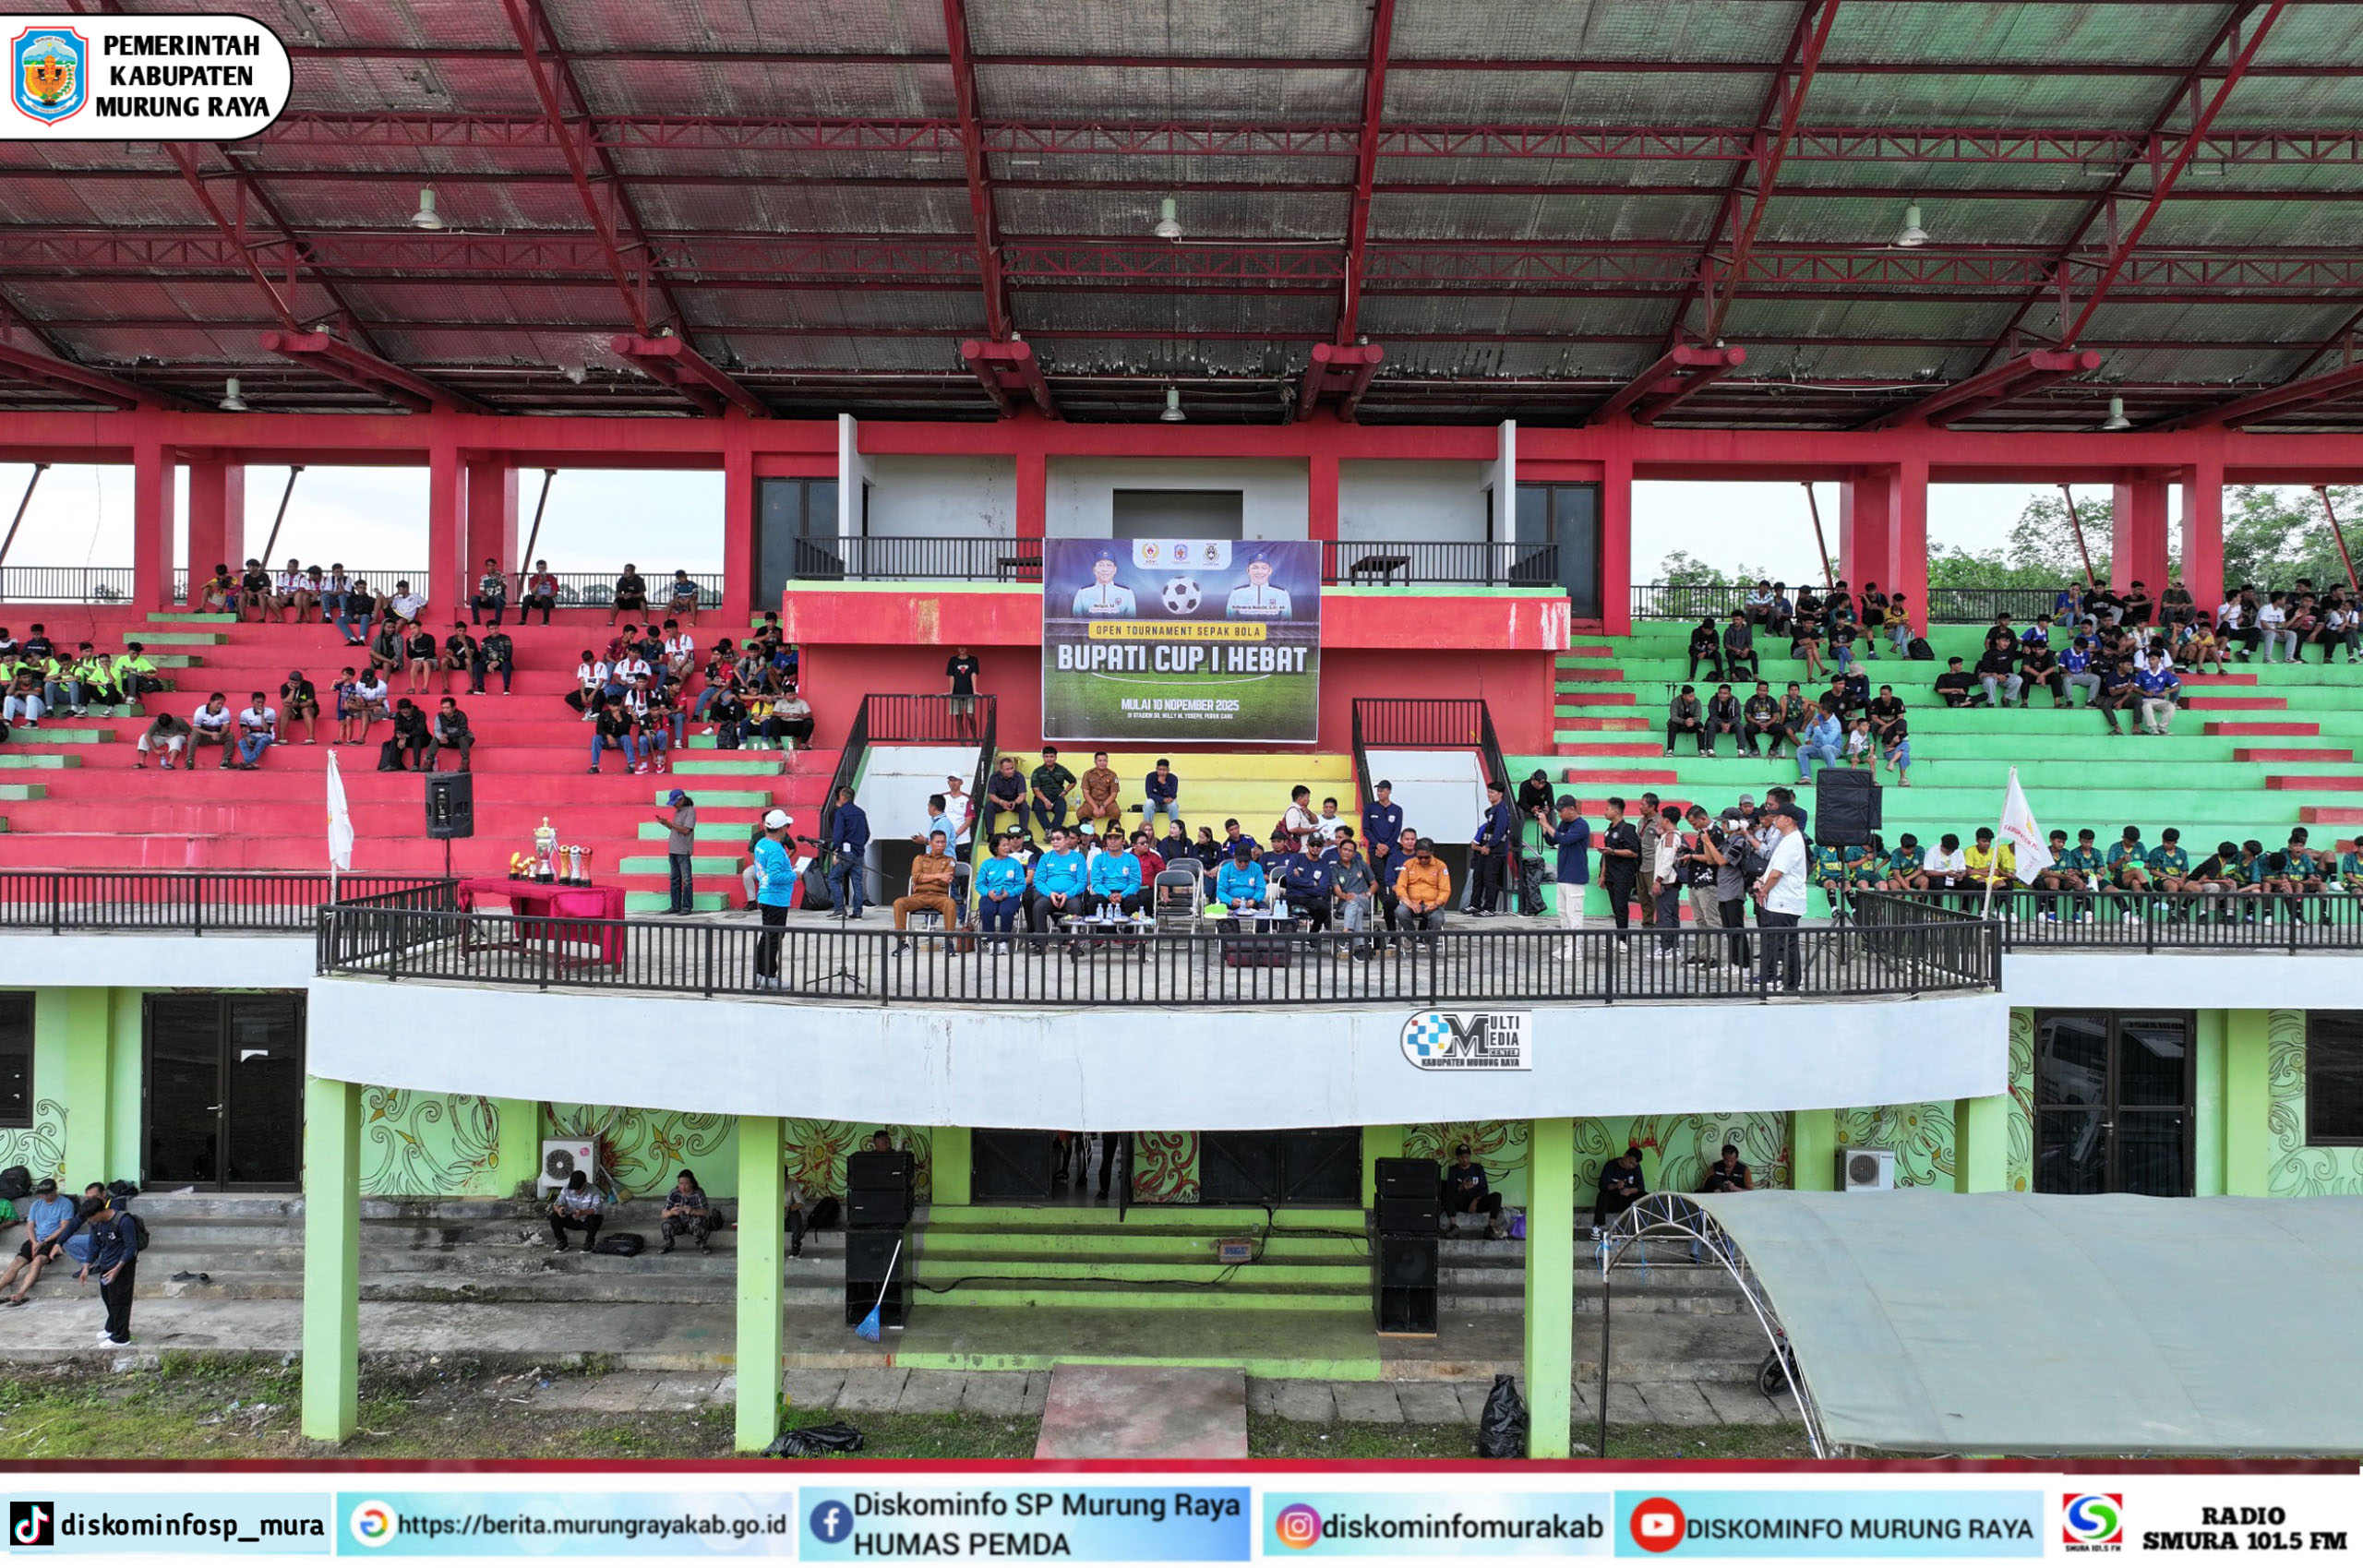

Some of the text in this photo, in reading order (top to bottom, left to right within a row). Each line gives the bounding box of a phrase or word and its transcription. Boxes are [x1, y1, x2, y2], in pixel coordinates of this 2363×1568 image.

[1096, 625, 1261, 637] OPEN TOURNAMENT SEPAK BOLA
[1058, 644, 1307, 673] BUPATI CUP I HEBAT
[1121, 699, 1240, 712] MULAI 10 NOPEMBER 2025
[1421, 1058, 1520, 1067] KABUPATEN MURUNG RAYA
